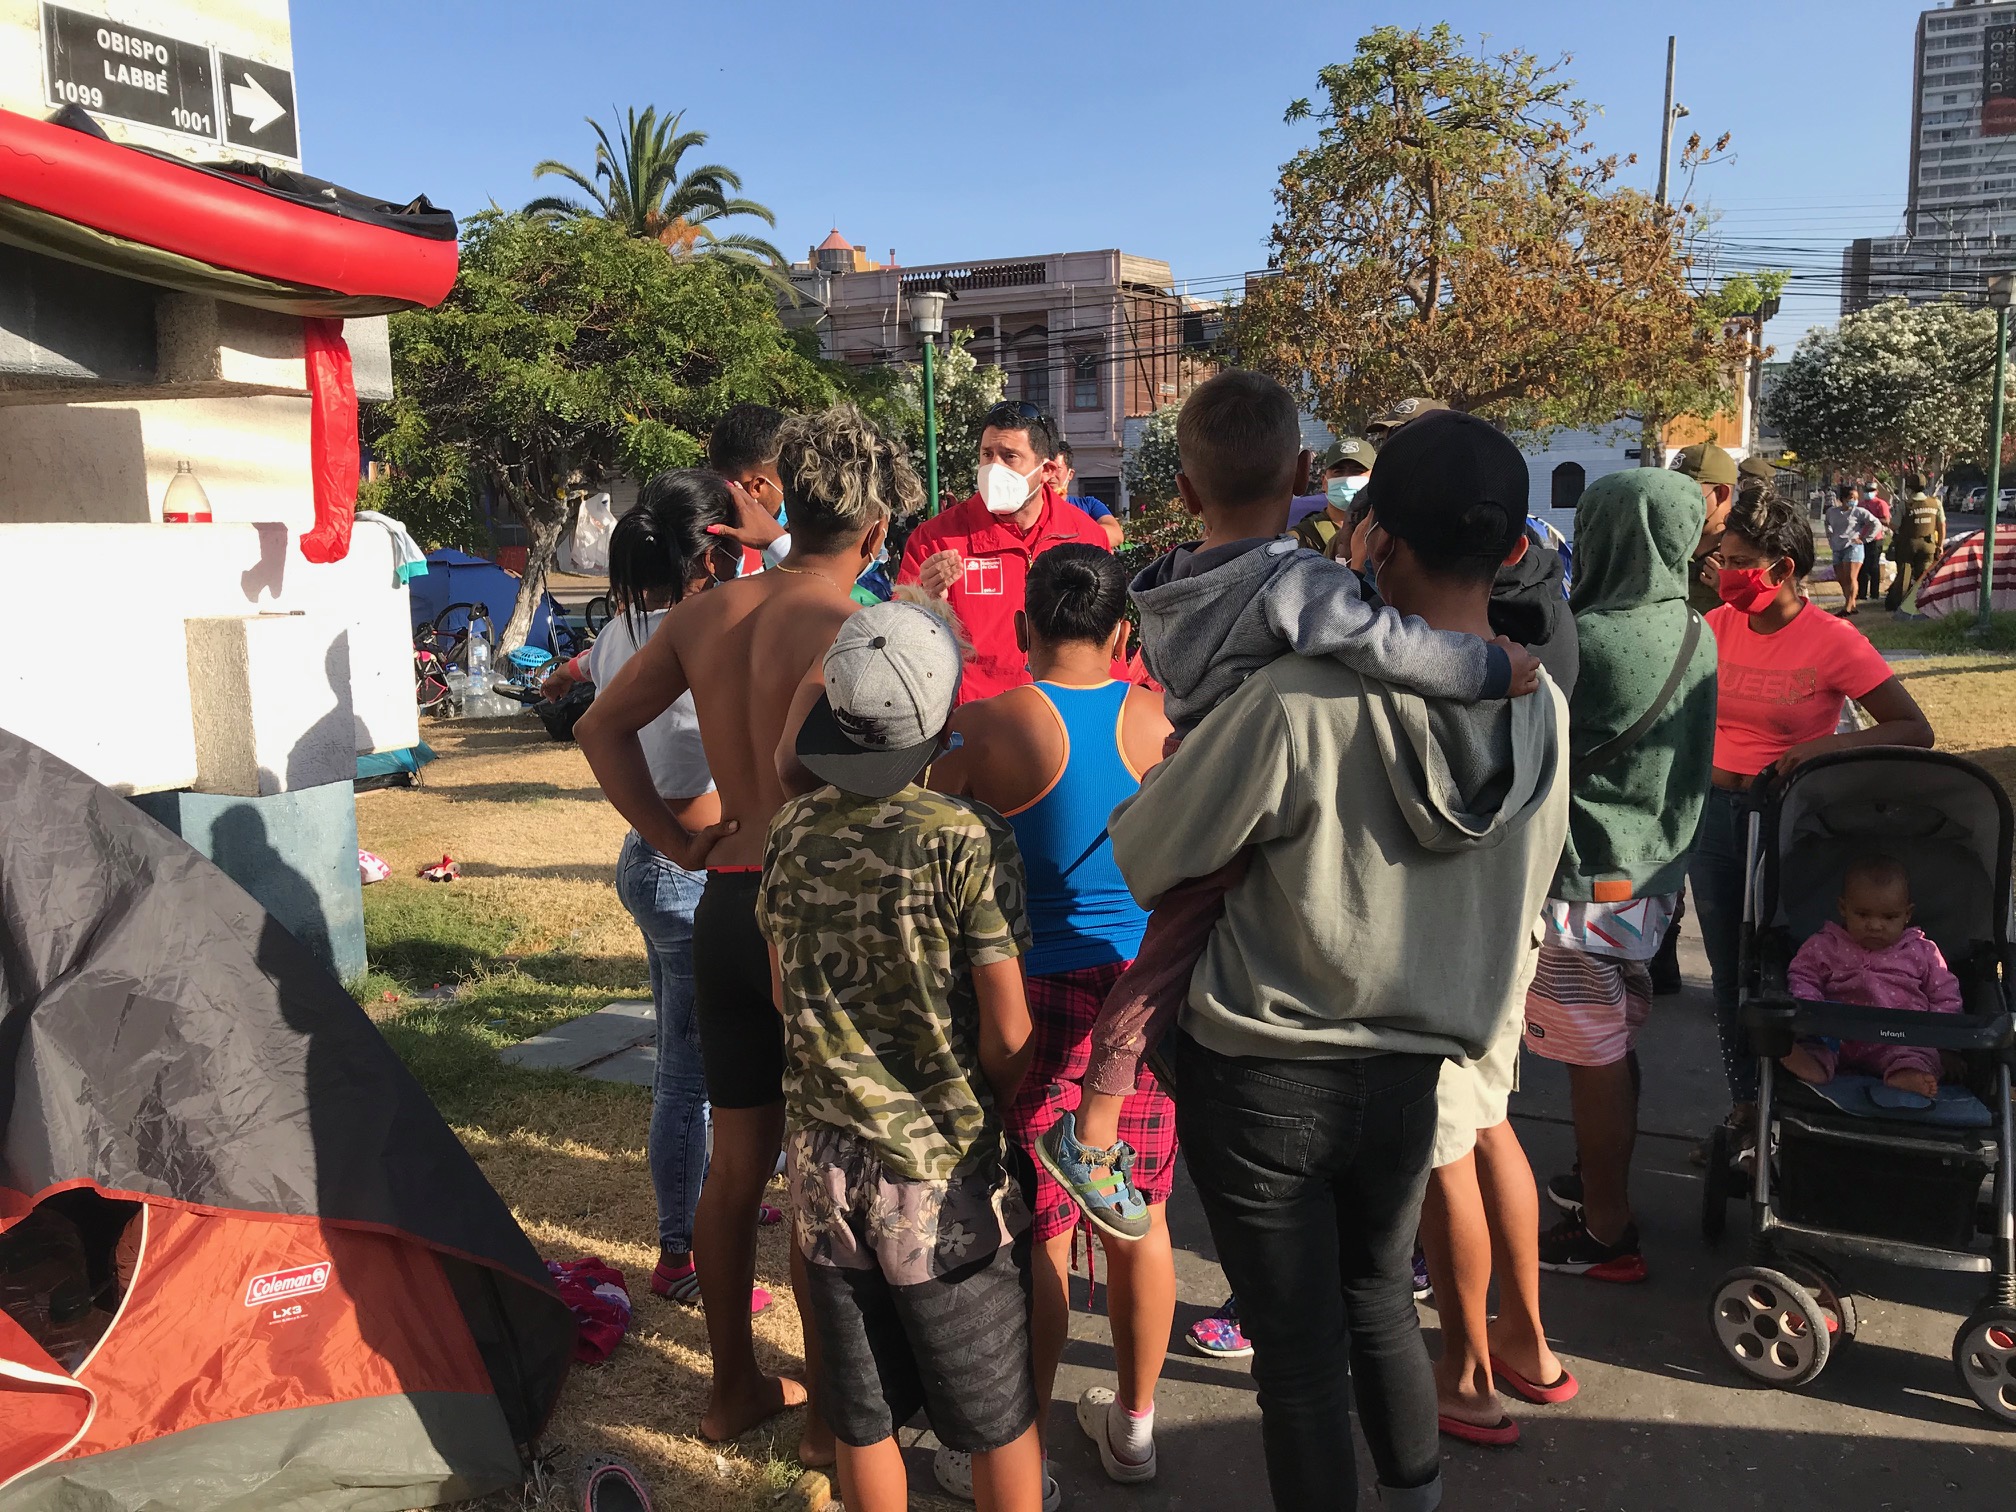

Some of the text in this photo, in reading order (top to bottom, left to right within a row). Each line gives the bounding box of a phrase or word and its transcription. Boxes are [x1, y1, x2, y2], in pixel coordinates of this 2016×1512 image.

[97, 28, 168, 65] OBISPO
[1990, 30, 2004, 94] DEPTOS
[103, 59, 169, 95] LABBÉ
[55, 79, 103, 108] 1099
[171, 106, 211, 134] 1001
[252, 1273, 312, 1298] Coleman
[272, 1305, 303, 1320] LX3
